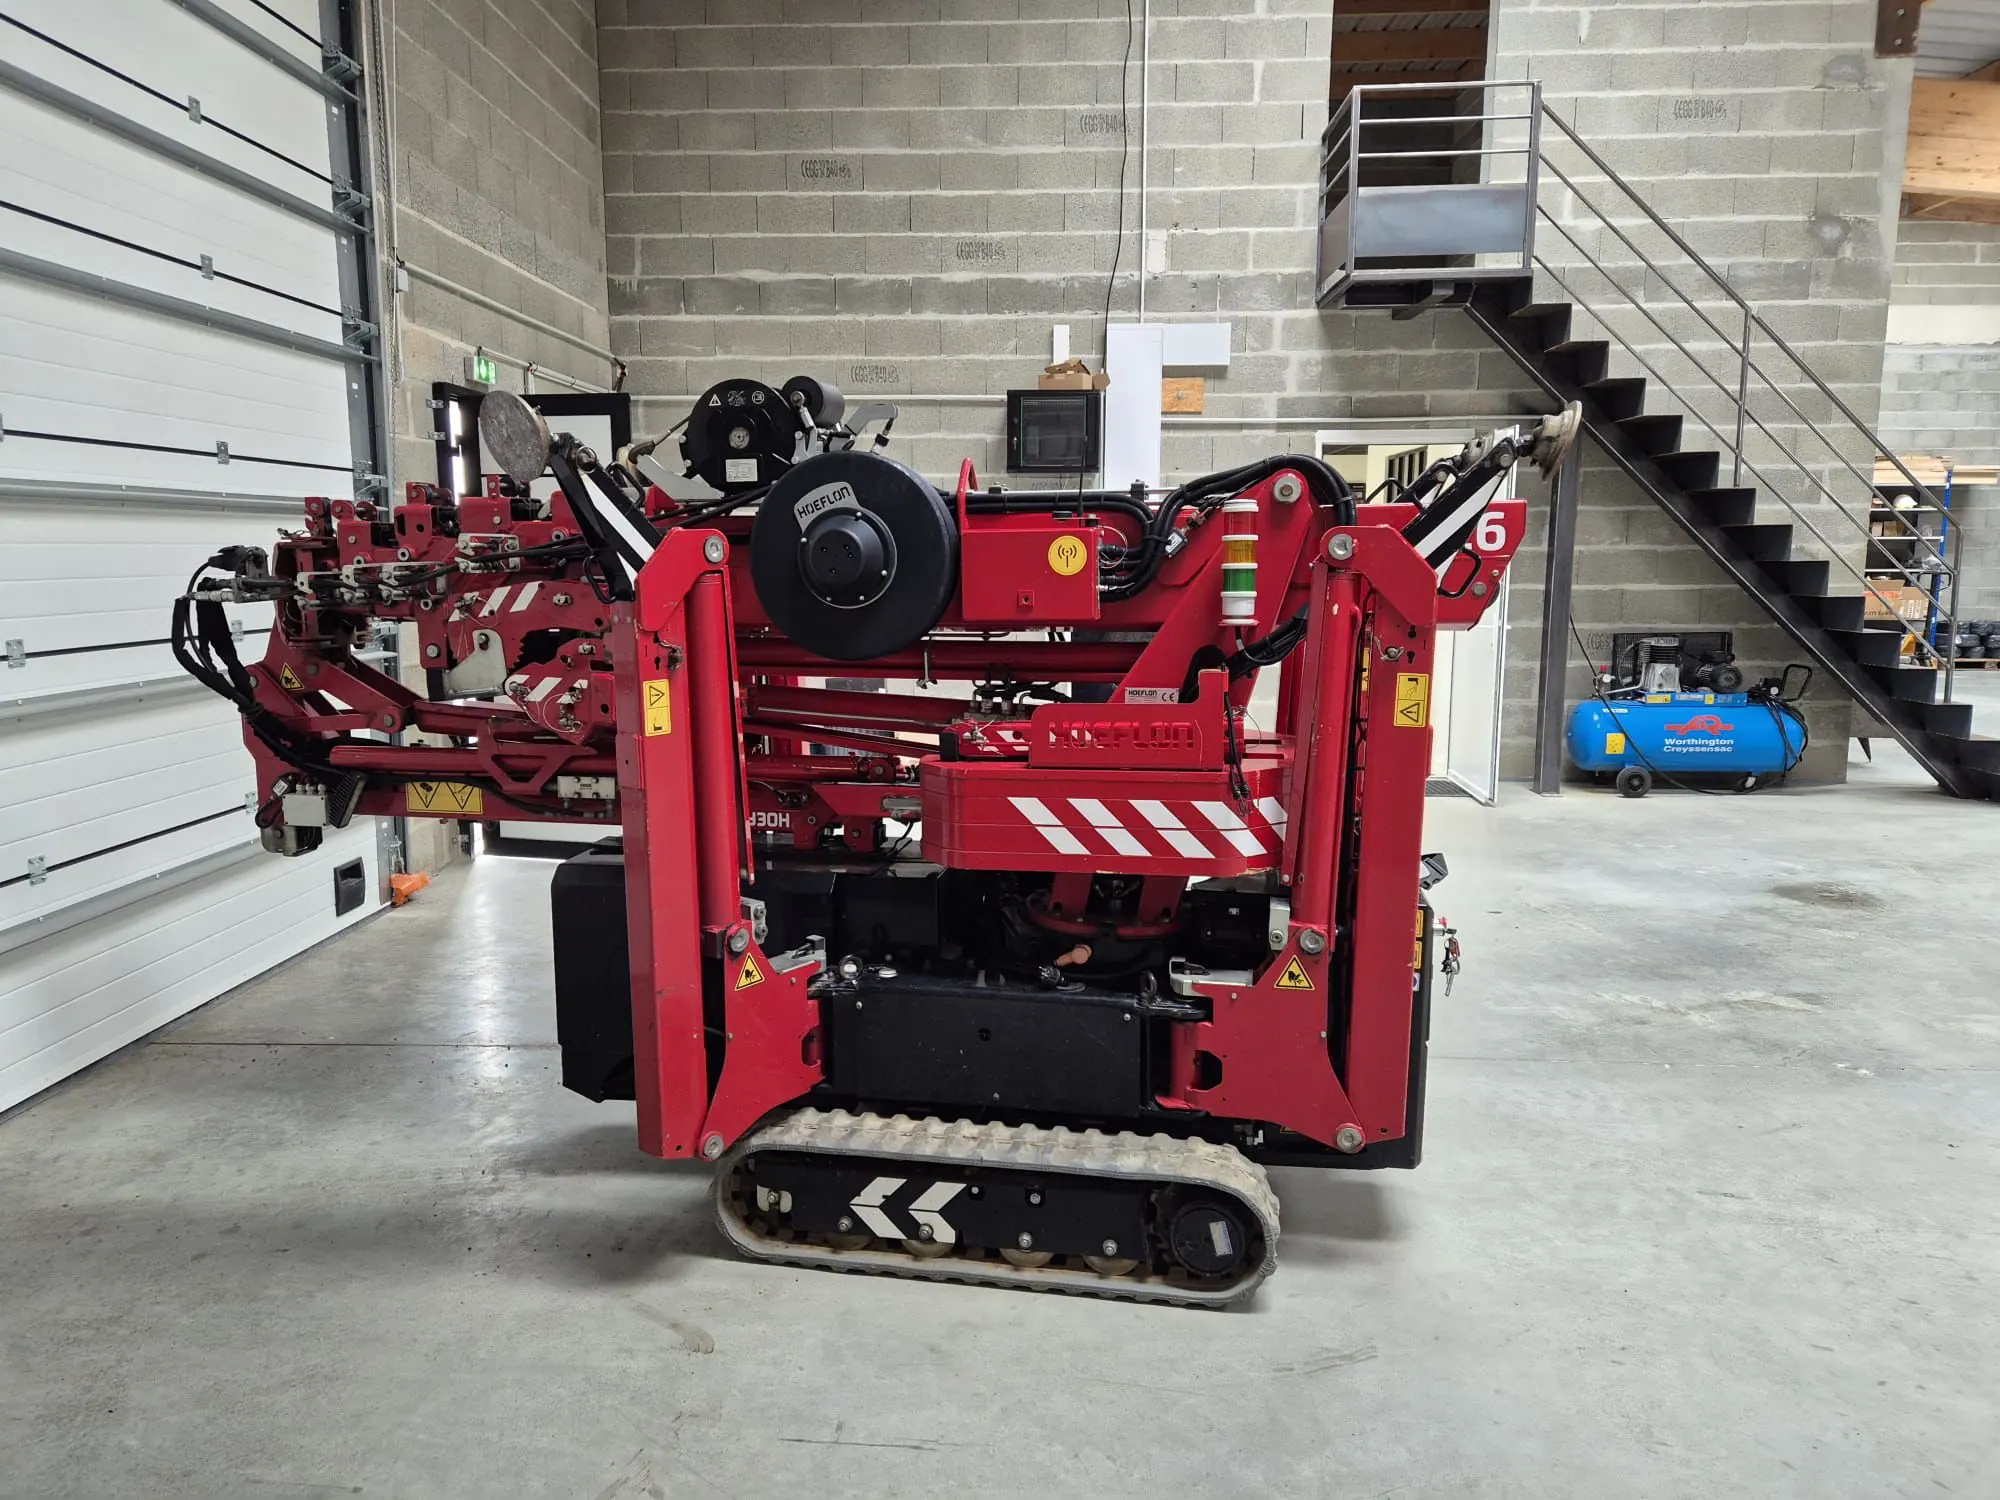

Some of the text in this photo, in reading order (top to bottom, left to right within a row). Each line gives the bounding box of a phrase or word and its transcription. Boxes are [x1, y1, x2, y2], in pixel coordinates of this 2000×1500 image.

[797, 486, 851, 519] HOEFLON
[1464, 511, 1506, 551] 6
[1128, 689, 1157, 697] HOEFLON
[1048, 720, 1194, 750] HOEFLON
[1664, 738, 1734, 746] Worthington
[1663, 745, 1733, 753] Creyssensac
